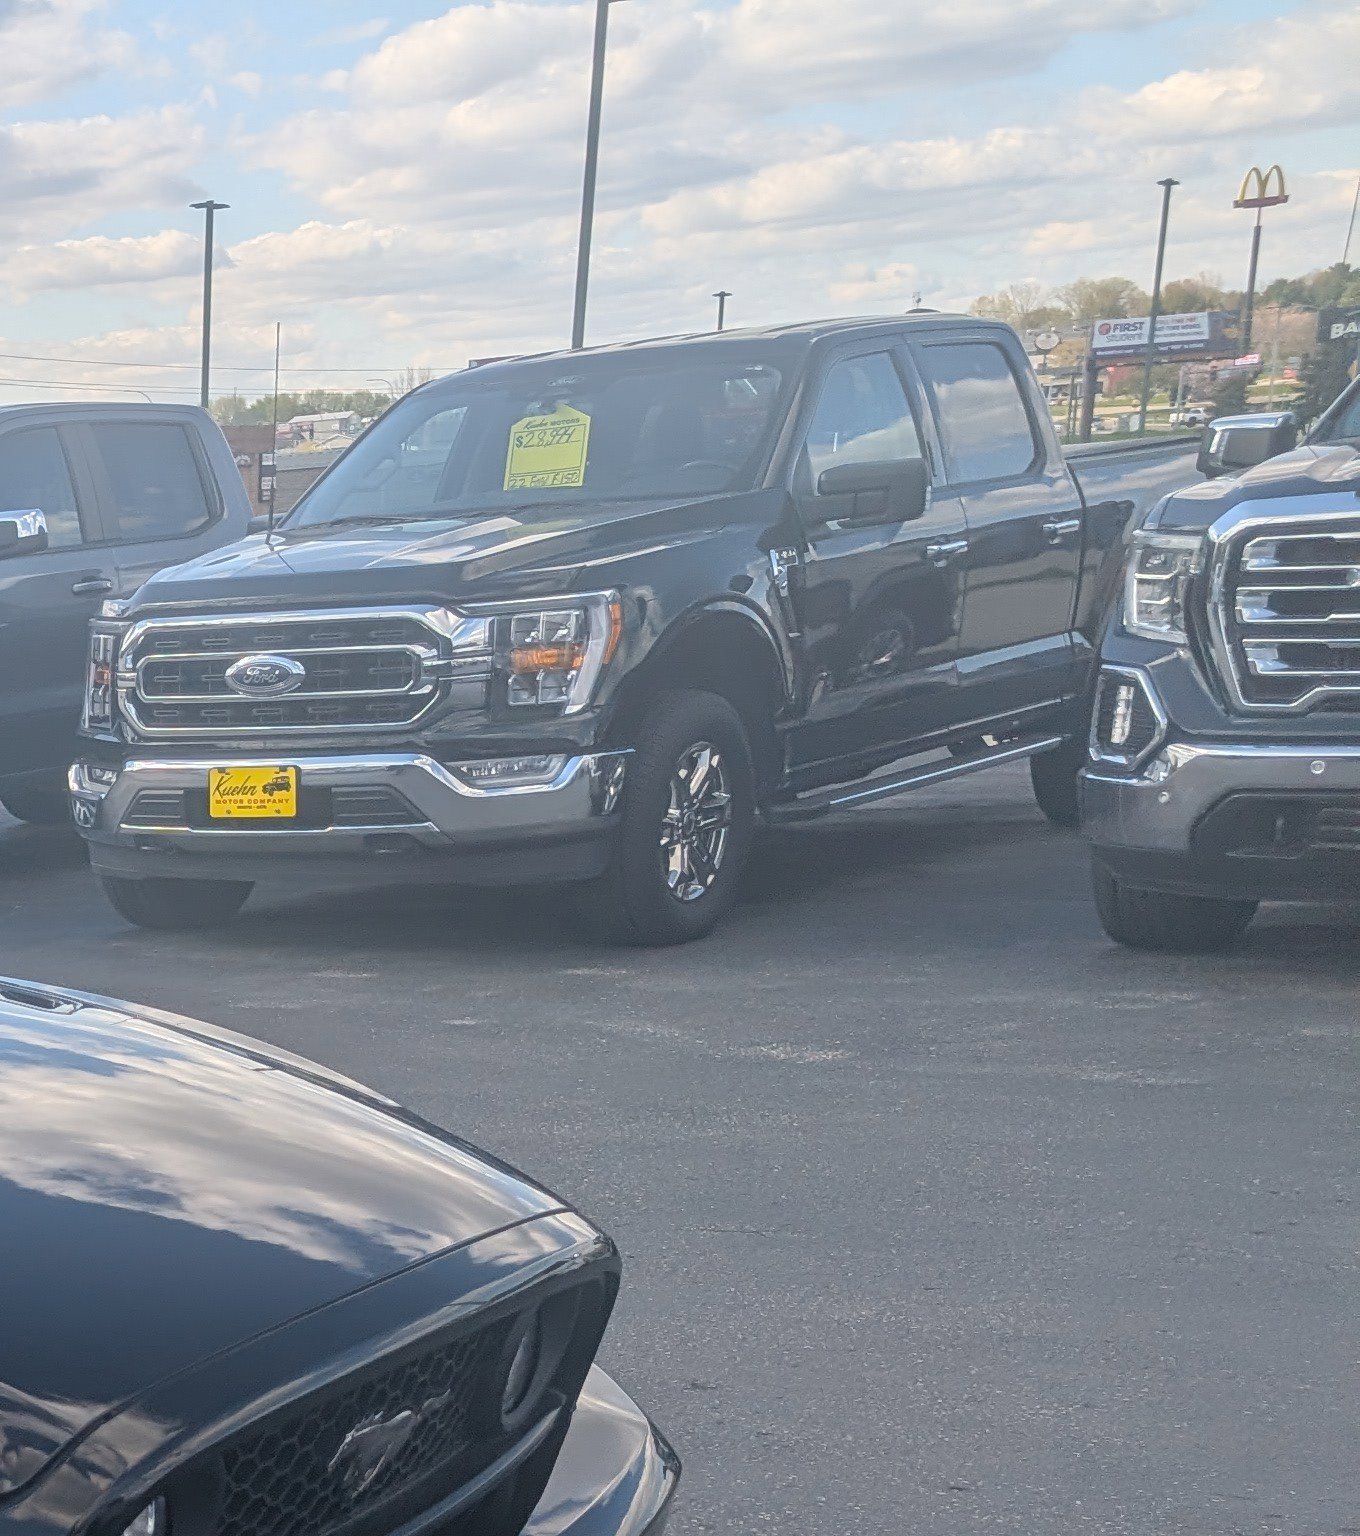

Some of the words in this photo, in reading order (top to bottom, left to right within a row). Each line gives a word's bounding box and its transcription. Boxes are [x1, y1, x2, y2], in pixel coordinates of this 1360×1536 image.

[1112, 321, 1145, 333] FIRST
[243, 666, 280, 684] Ford
[212, 775, 258, 799] Kuehn
[247, 797, 290, 805] COMPANY
